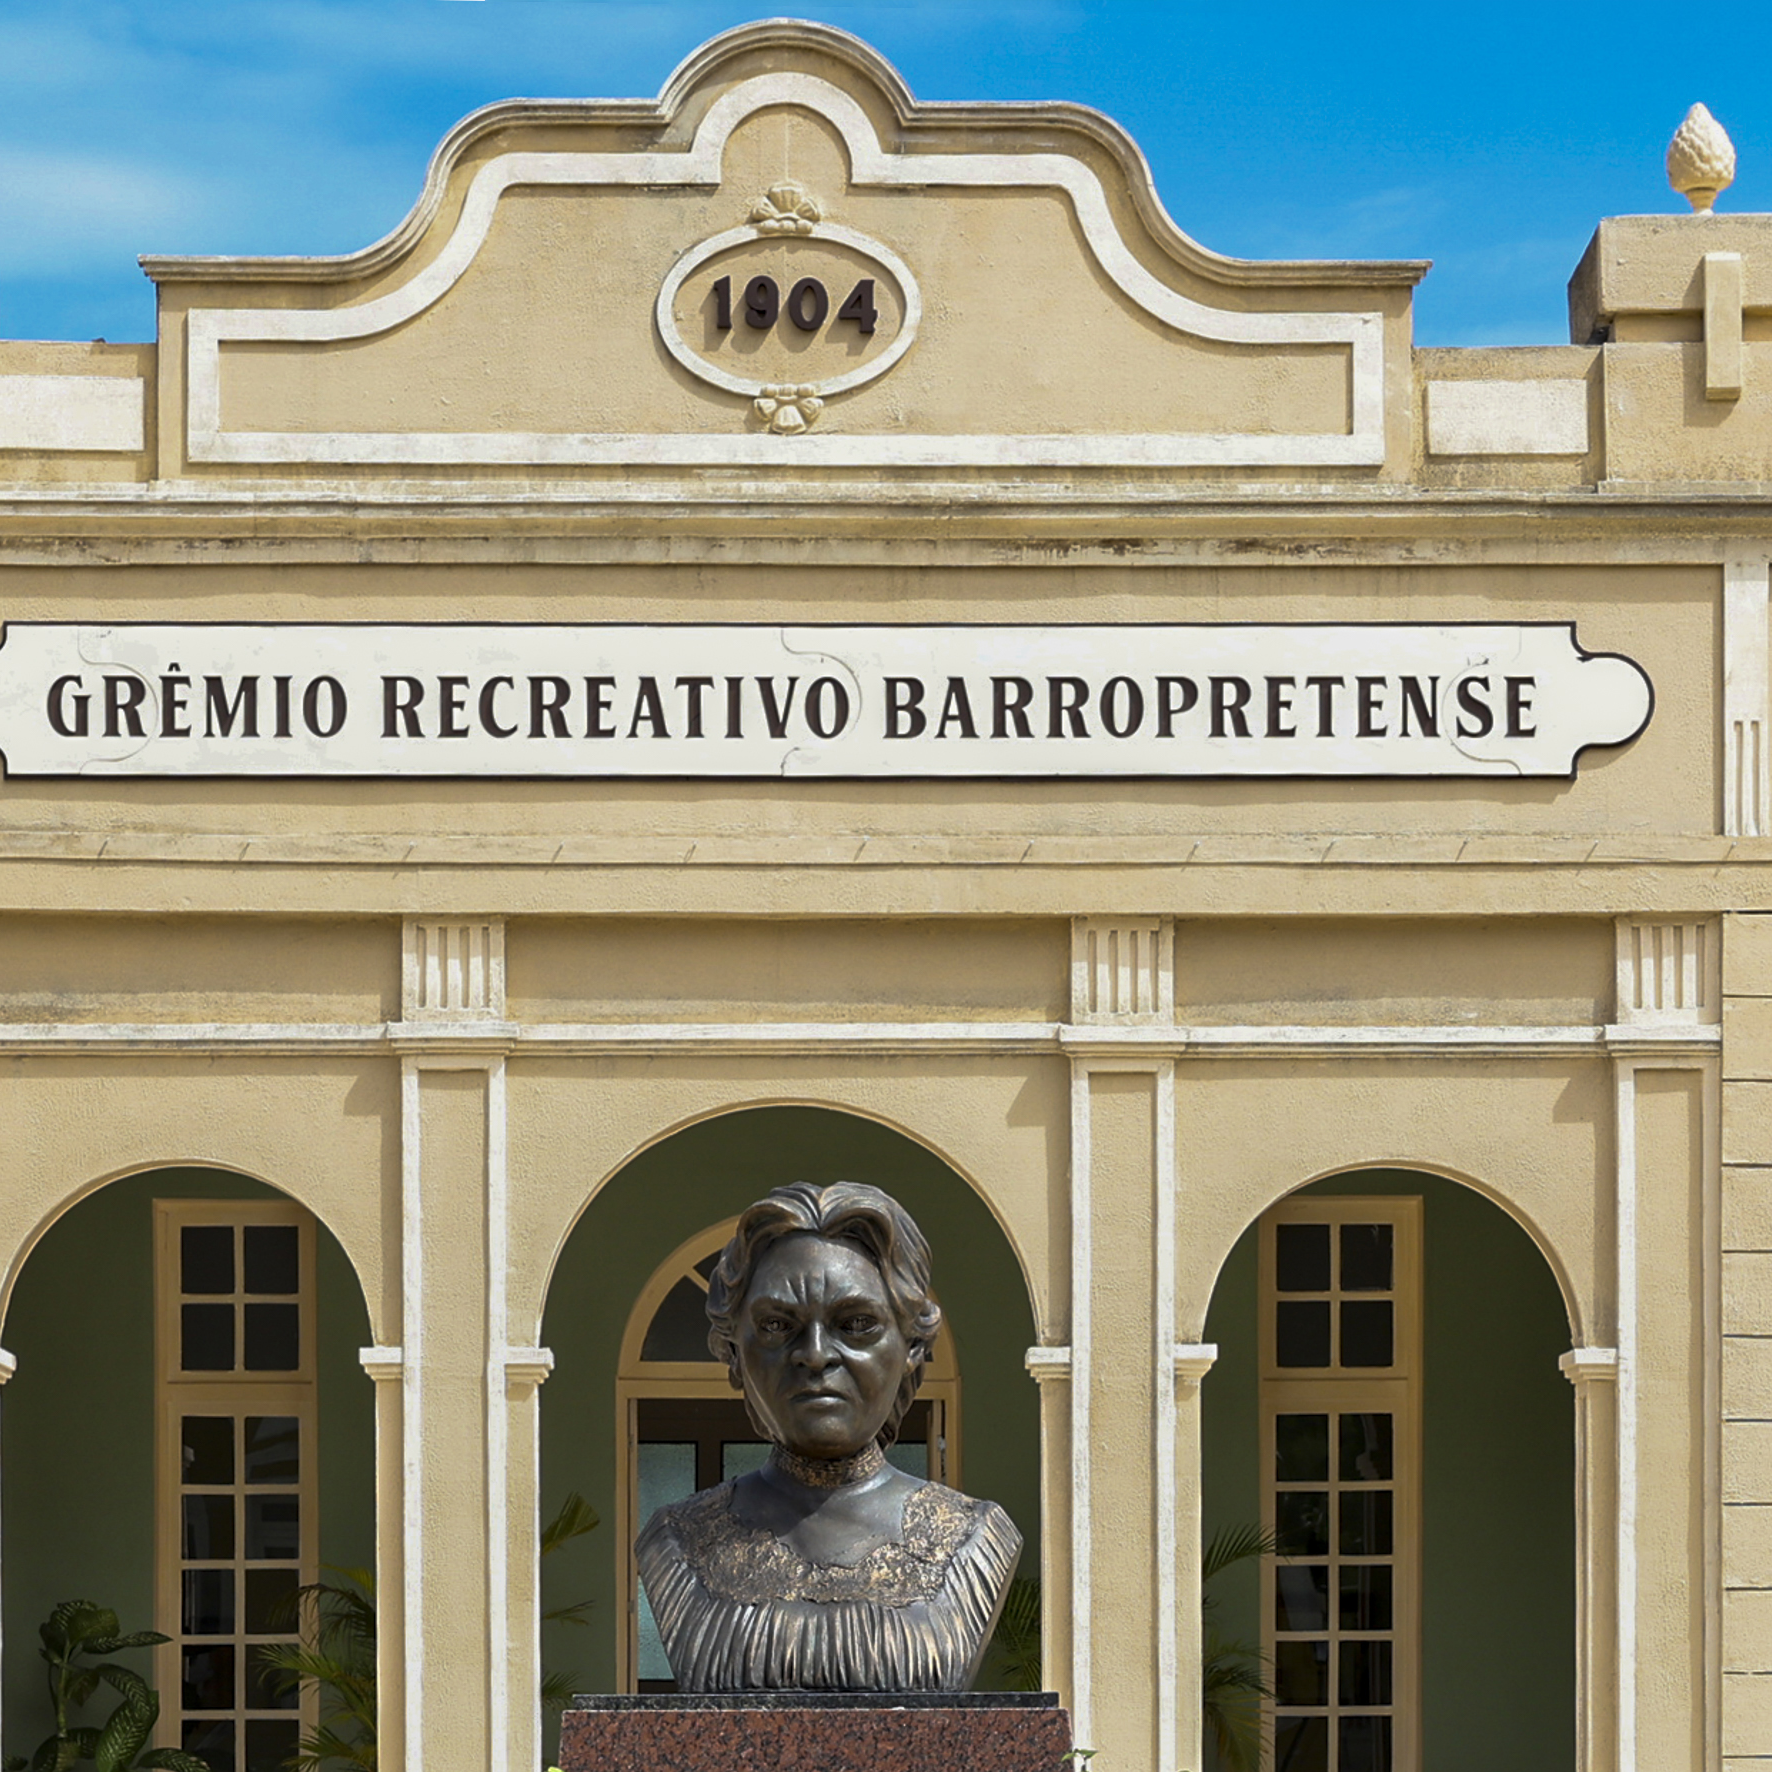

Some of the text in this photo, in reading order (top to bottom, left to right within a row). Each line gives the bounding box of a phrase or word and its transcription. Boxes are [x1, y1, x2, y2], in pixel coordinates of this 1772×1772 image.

[713, 275, 879, 334] 1904
[45, 662, 1539, 740] GRÊMIO RECREATIVO BARROPRETENSE
